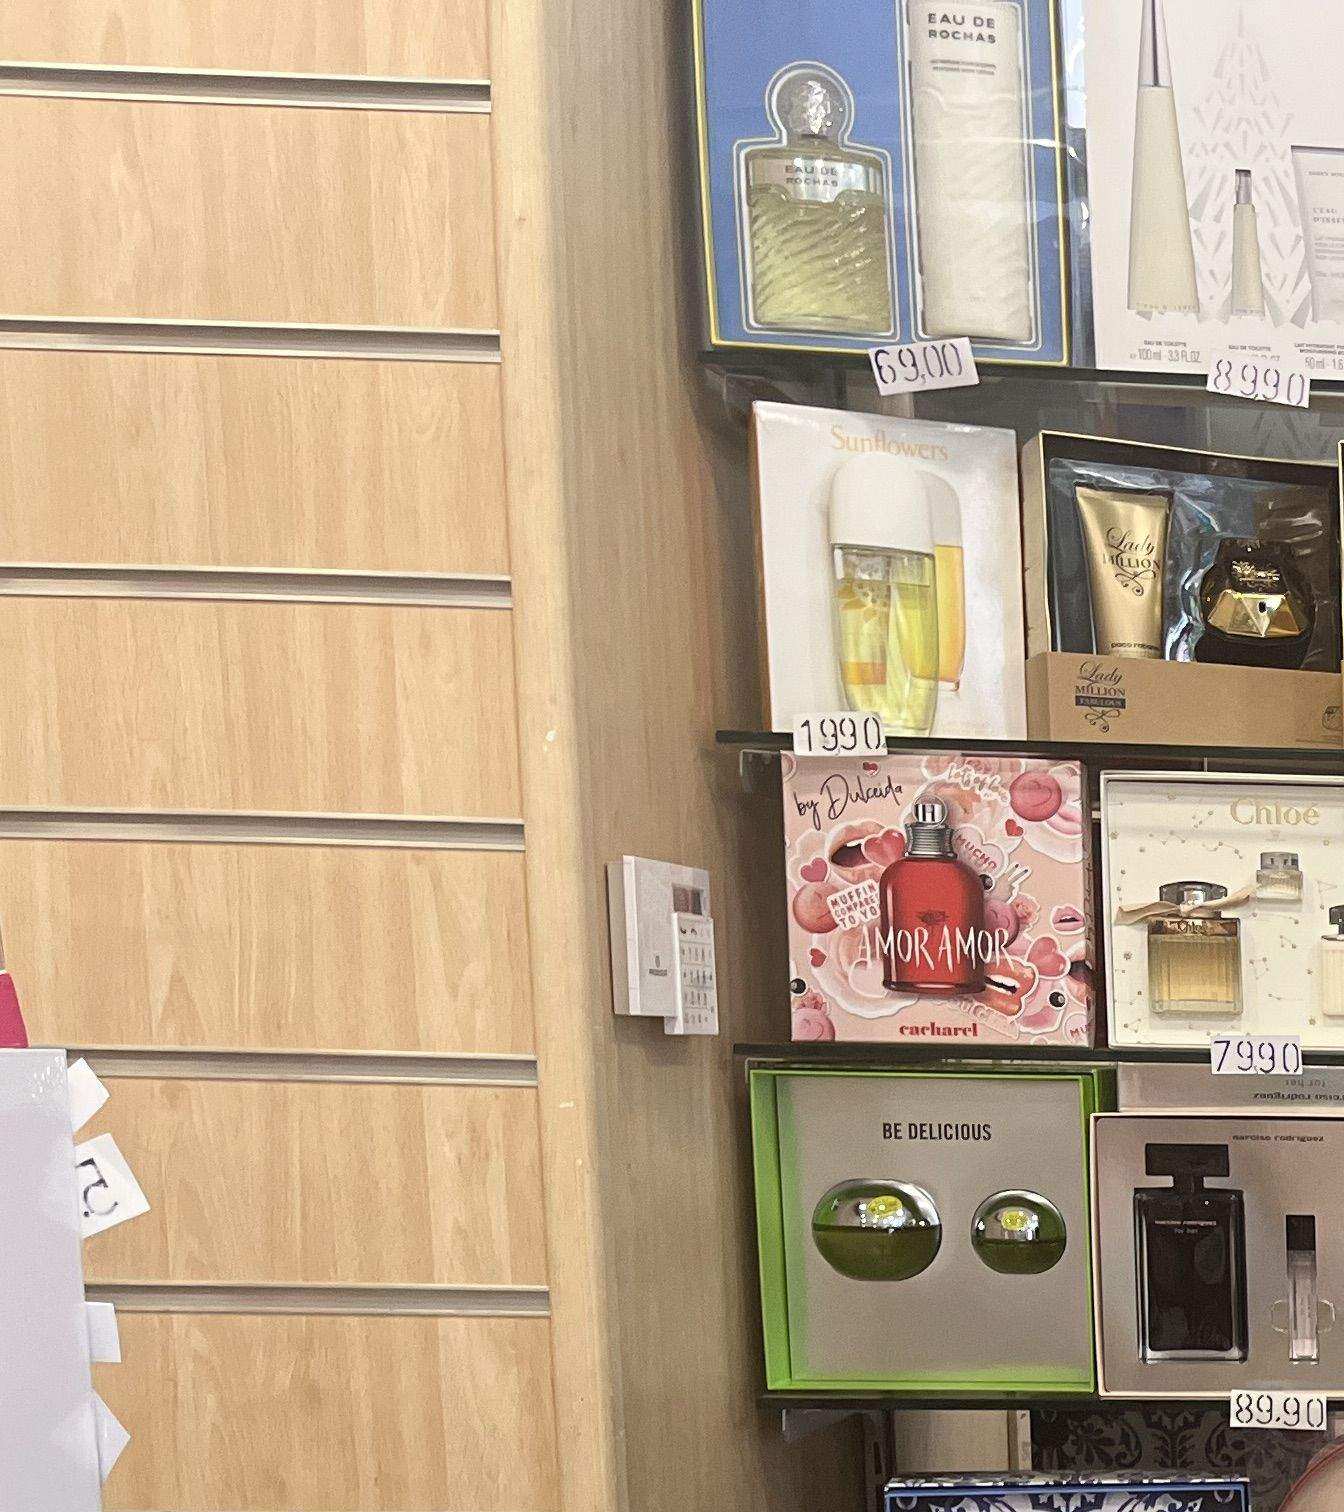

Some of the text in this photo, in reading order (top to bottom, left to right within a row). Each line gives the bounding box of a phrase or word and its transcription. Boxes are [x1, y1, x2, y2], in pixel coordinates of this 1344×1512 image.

[927, 12, 996, 30] EAU DE
[927, 26, 998, 45] ROCHAS
[831, 424, 948, 462] Sunflowers
[1102, 554, 1162, 572] MILLION
[1230, 799, 1320, 828] Chloé
[857, 925, 1015, 969] AMOR AMOR
[899, 1021, 979, 1038] cacharel
[883, 1122, 992, 1141] BE DELICIOUS
